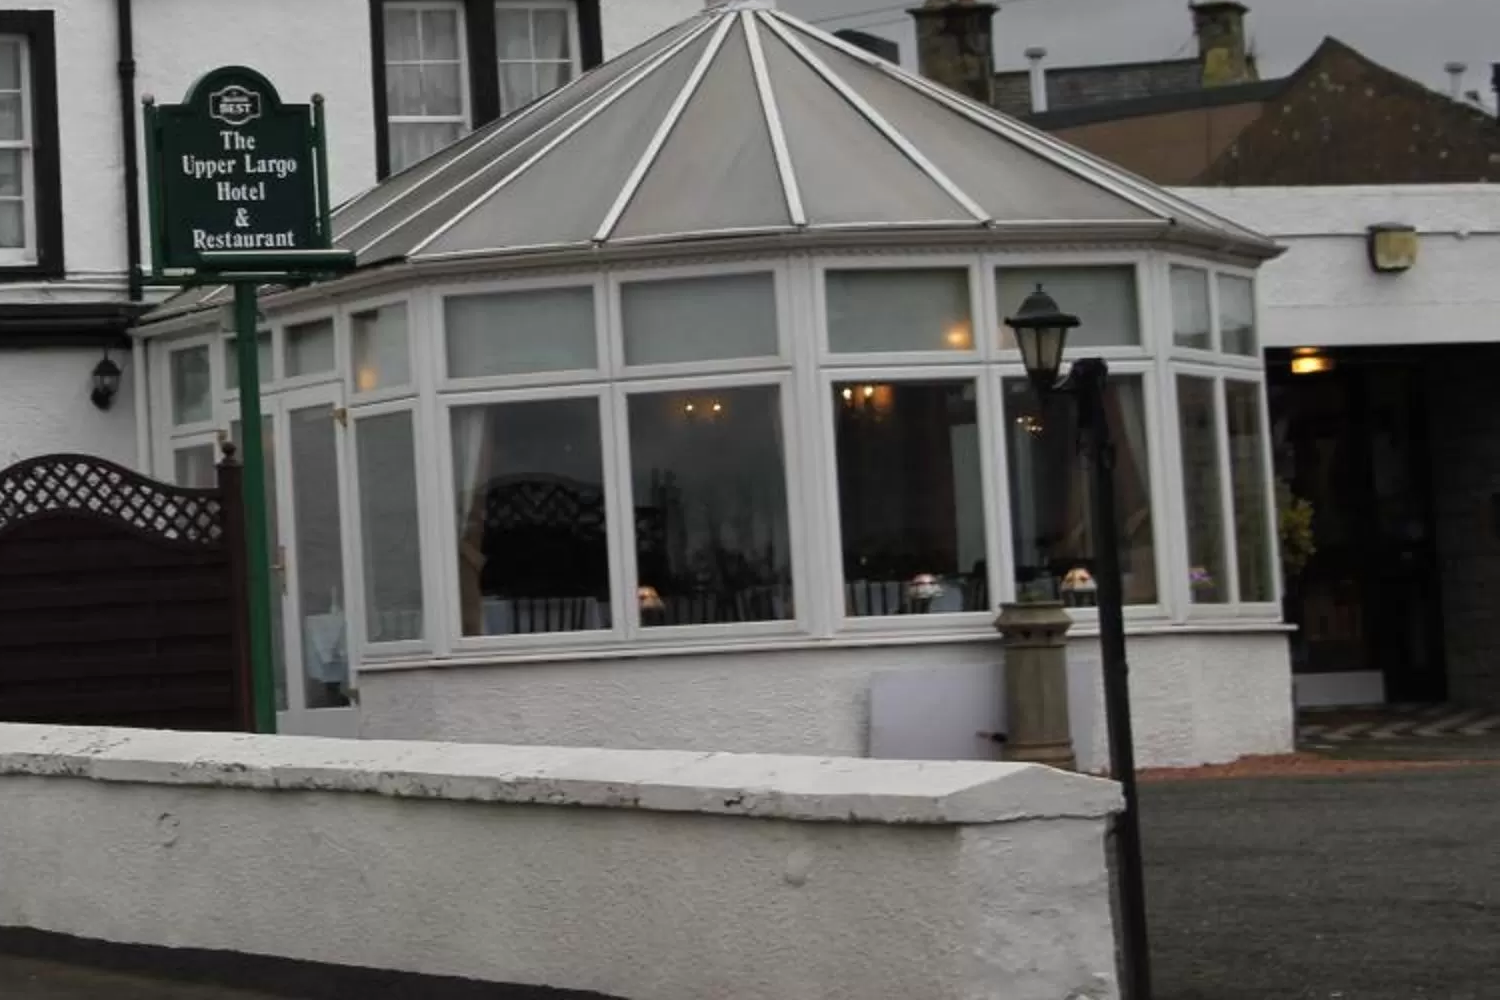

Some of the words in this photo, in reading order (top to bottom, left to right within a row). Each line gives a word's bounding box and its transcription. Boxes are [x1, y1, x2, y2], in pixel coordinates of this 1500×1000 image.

[220, 130, 257, 150] The
[182, 154, 236, 179] Upper
[243, 153, 298, 178] Largo
[216, 181, 266, 201] Hotel
[235, 207, 250, 227] &
[192, 229, 296, 249] Restaurant
